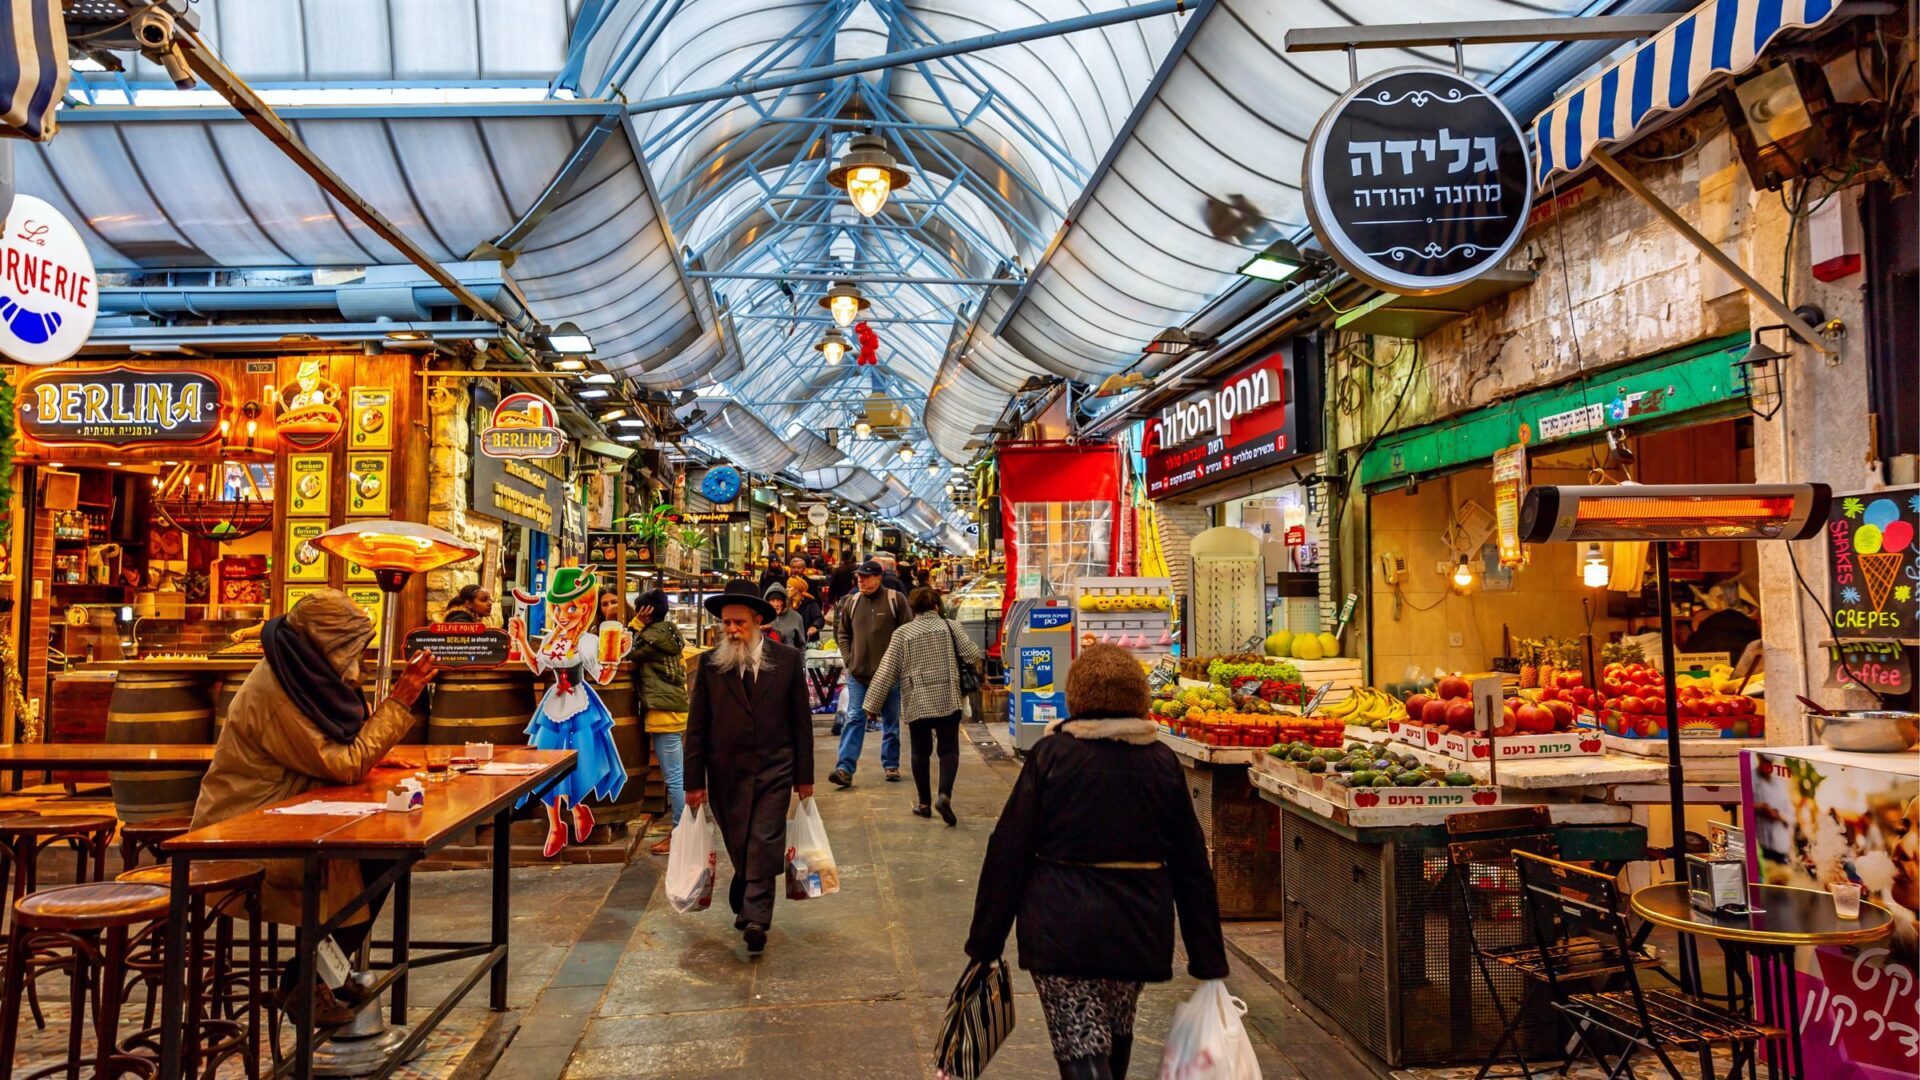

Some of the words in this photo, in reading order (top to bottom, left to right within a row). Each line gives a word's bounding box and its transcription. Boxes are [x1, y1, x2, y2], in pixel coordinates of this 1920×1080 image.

[1348, 128, 1499, 177] גלידה
[1354, 187, 1425, 207] יהודה
[1434, 184, 1502, 205] מחנה
[17, 219, 50, 246] La
[0, 247, 91, 308] RNERIE
[35, 383, 202, 429] BERLINA
[1215, 369, 1273, 436] מחסן
[83, 427, 115, 436] אמיתית
[1154, 398, 1212, 450] הסלולר
[491, 432, 553, 449] BERLINA
[1207, 437, 1224, 455] רשת
[1829, 519, 1854, 585] SHAKES
[436, 624, 458, 632] SELFIE
[460, 624, 479, 633] POINT
[1835, 609, 1900, 629] CREPES
[1836, 663, 1902, 687] Coffee
[1406, 728, 1421, 739] ברעם
[1446, 740, 1464, 753] ברעם
[1502, 745, 1536, 756] ברעם
[1539, 743, 1572, 754] פירות
[1388, 795, 1424, 806] ברעם
[1427, 794, 1464, 805] פירות
